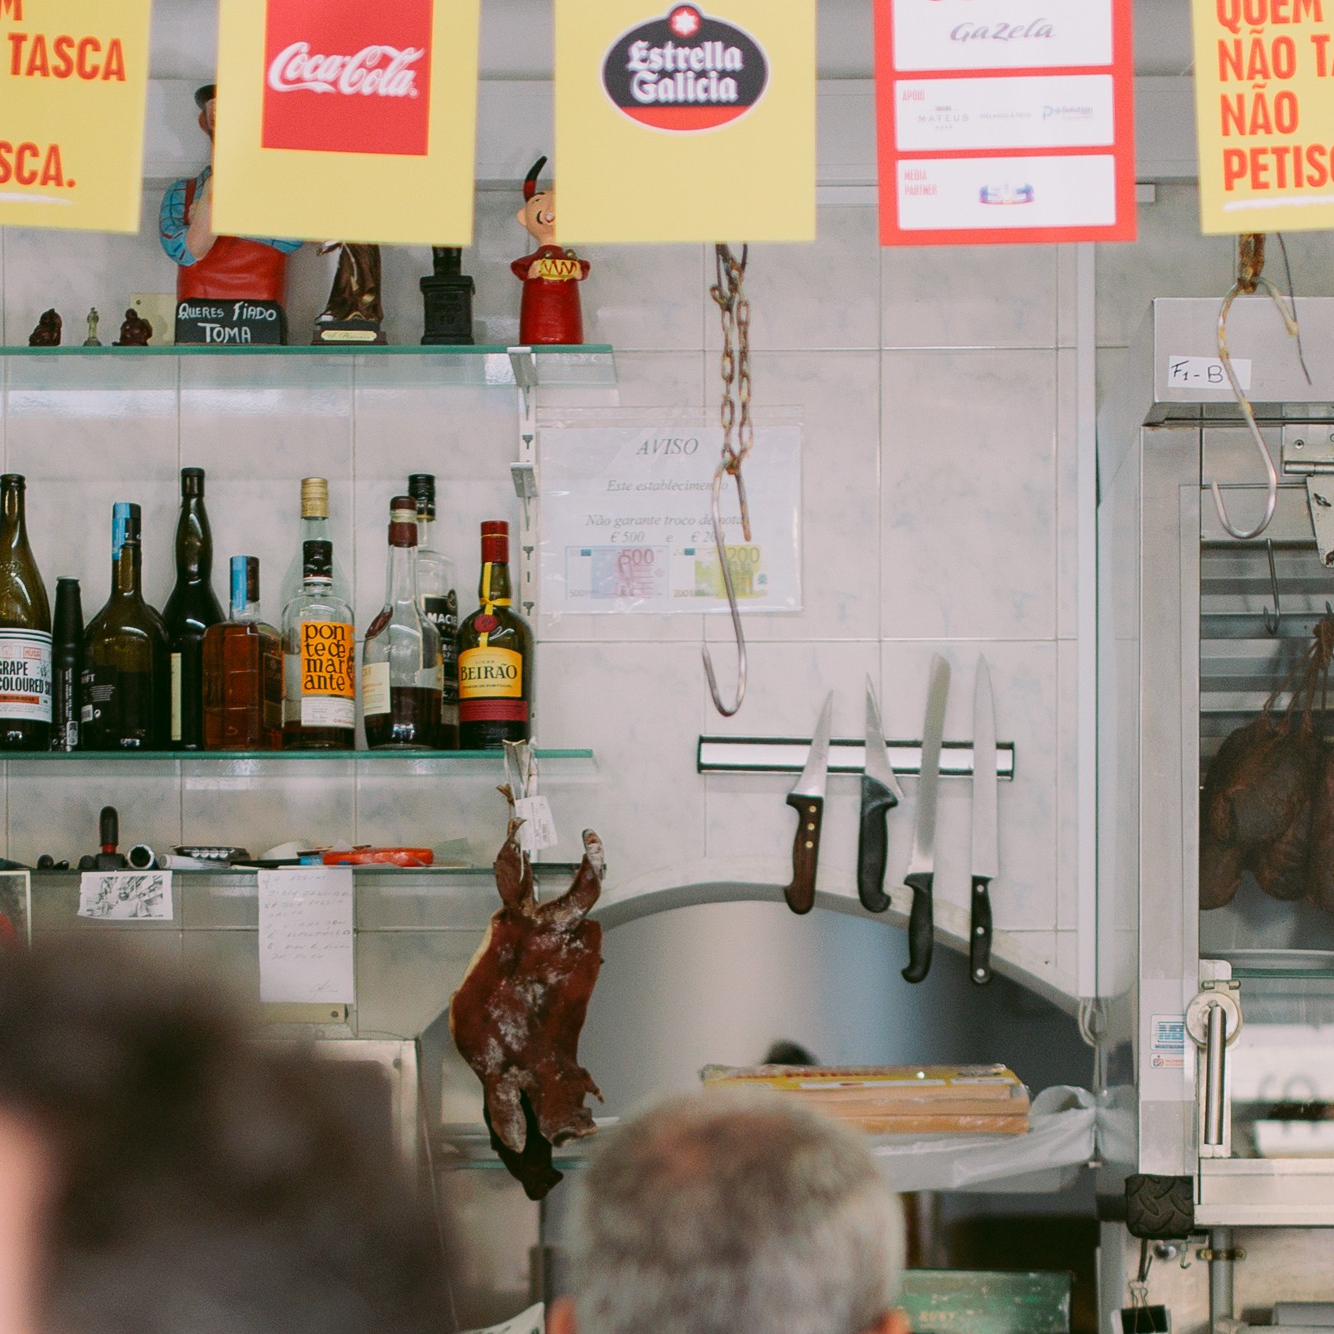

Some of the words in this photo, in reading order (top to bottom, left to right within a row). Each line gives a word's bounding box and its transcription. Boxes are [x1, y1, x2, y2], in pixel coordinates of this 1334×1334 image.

[949, 17, 1055, 42] Gazela
[7, 32, 126, 82] TASCA
[628, 40, 744, 71] Estrella
[1217, 28, 1297, 82] NÃO
[631, 70, 739, 104] Galicia
[1220, 82, 1300, 136] NÃO
[178, 303, 224, 320] QUERES
[197, 323, 252, 343] TOMA
[636, 438, 699, 456] AVISO
[606, 480, 634, 492] Este
[636, 479, 729, 493] establecimeno
[585, 515, 612, 527] Não
[614, 515, 663, 529] garante
[664, 516, 697, 526] troco
[304, 624, 346, 642] pon
[304, 658, 346, 674] mar
[460, 662, 518, 681] BEIRÃO
[303, 674, 346, 691] ante
